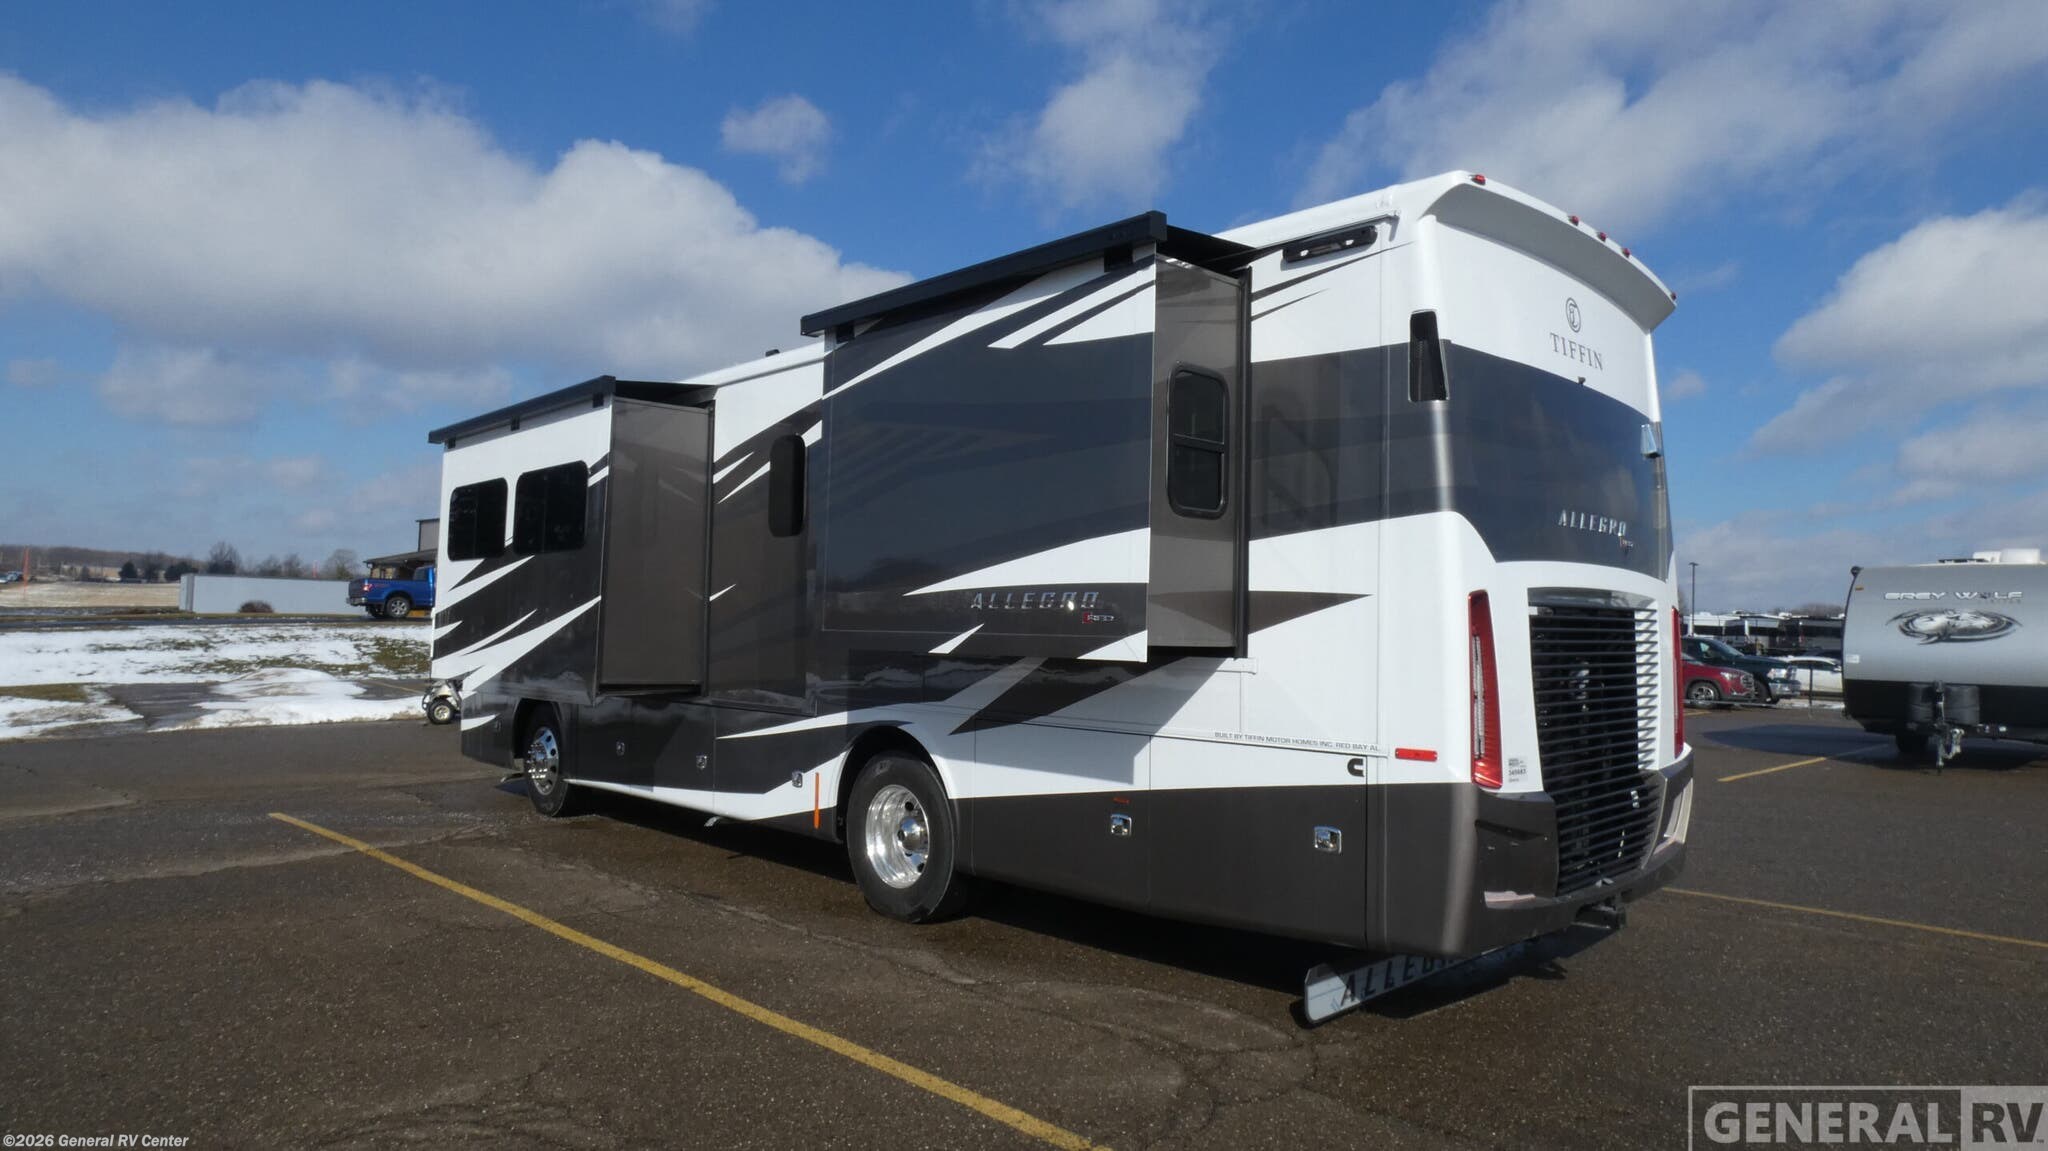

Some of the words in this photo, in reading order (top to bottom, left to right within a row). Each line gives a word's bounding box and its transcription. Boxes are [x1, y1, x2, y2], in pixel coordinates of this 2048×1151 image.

[1550, 332, 1603, 371] TIFFIN
[1558, 509, 1627, 537] ALLEGRO
[971, 592, 1099, 610] ALLEGRO
[1884, 592, 1946, 600] GREY
[1244, 734, 1264, 742] TIFFIN
[1265, 736, 1291, 744] MOTOR
[1292, 738, 1318, 746] HOMES
